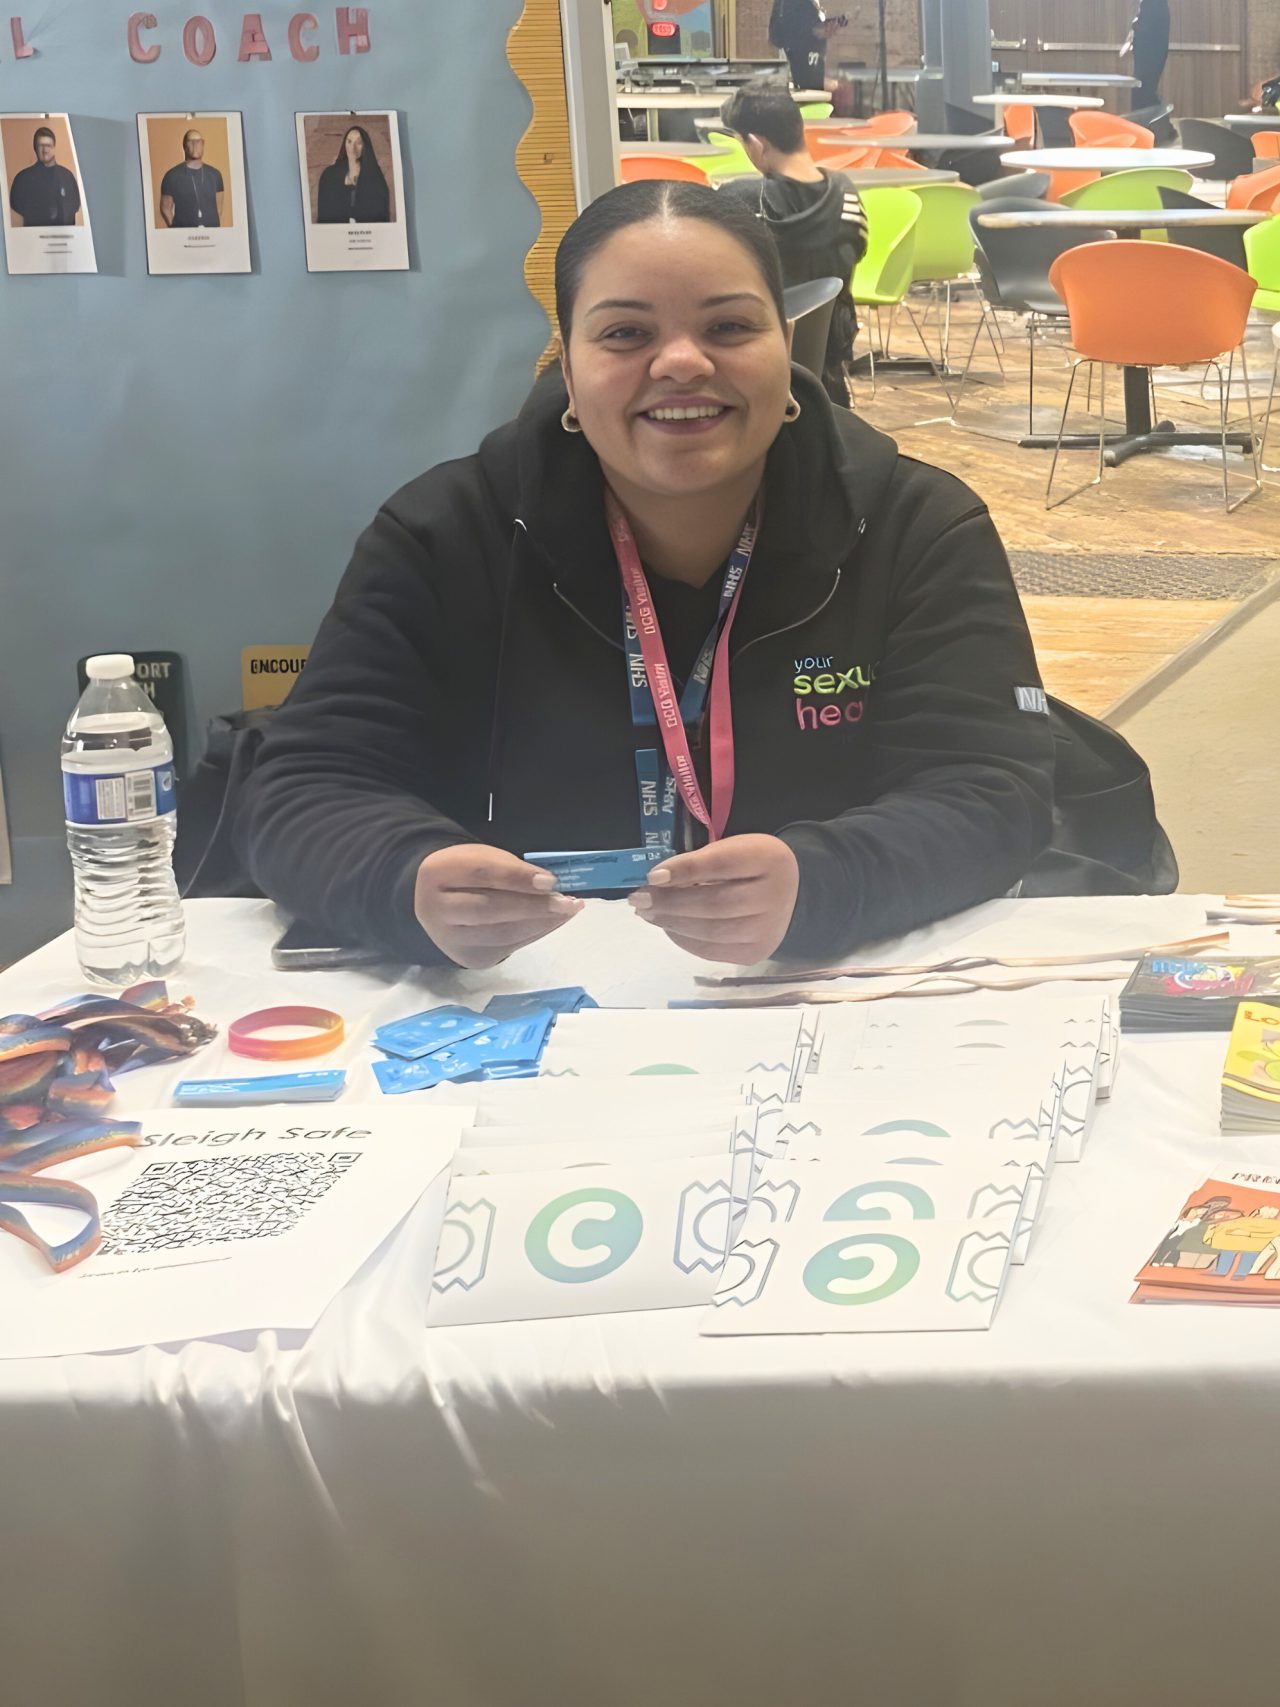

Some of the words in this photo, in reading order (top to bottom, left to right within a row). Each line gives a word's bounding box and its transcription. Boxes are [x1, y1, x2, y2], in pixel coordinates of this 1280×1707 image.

[10, 16, 34, 60] L
[127, 6, 371, 66] COACH
[793, 660, 880, 695] sexu
[794, 656, 834, 674] your
[641, 780, 658, 816] NHS
[141, 1127, 267, 1147] Sleigh
[277, 1126, 373, 1140] Safe
